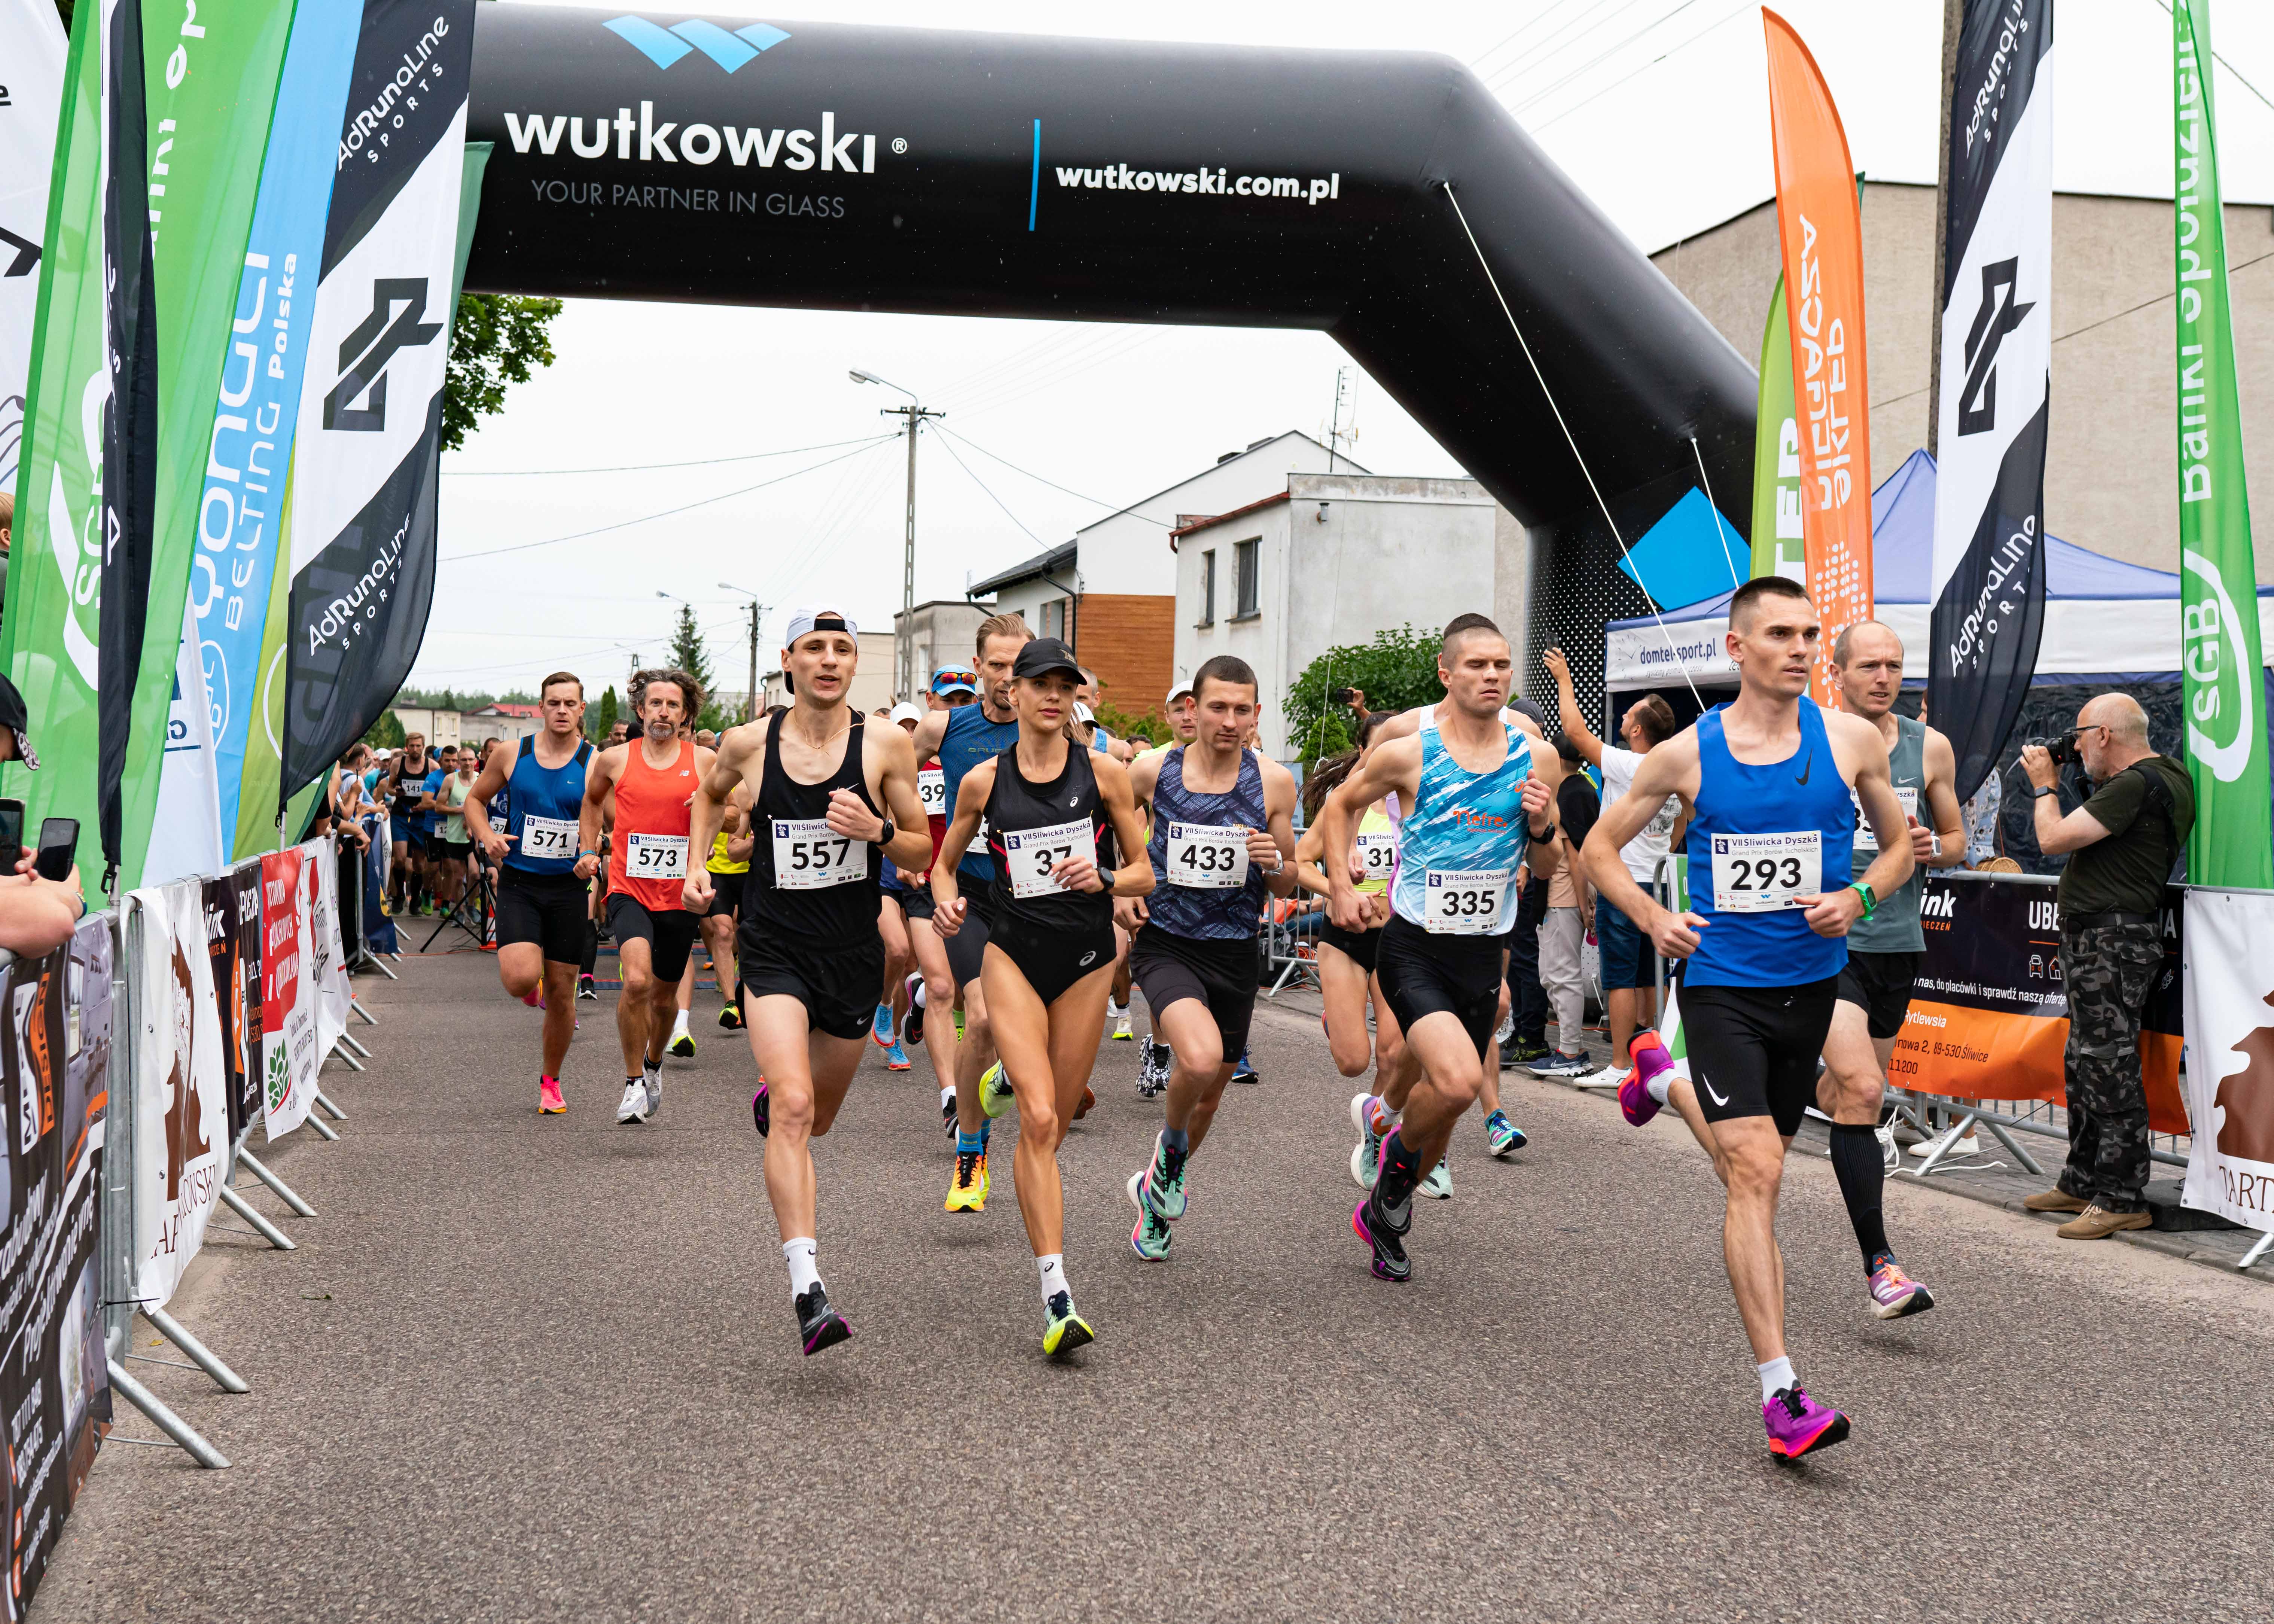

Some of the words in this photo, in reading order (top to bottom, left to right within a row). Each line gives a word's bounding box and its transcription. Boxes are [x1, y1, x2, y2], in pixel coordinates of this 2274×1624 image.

[368, 64, 443, 163] SPORTS
[504, 100, 876, 173] wutkowski
[1056, 164, 1339, 205] wutkowski.com.pl
[531, 179, 603, 205] YOUR
[613, 185, 719, 212] PARTNER
[729, 191, 756, 214] IN
[766, 193, 845, 218] GLASS
[225, 404, 281, 631] BELTING
[268, 254, 297, 379] Polska
[343, 558, 402, 650] SPORTS
[1973, 581, 2025, 669] SPORT
[1640, 638, 1716, 664] domtel-sport.pl
[2184, 598, 2220, 720] SGB
[533, 830, 567, 848] 571
[1033, 829, 1064, 839] Śliwicka
[1066, 822, 1091, 834] Dyszka
[1067, 831, 1091, 842] Tucholskich
[1195, 827, 1223, 836] Śliwicka
[1744, 837, 1781, 846] Śliwicka
[1786, 836, 1817, 845] Dyszka
[638, 848, 677, 867] 573
[792, 839, 850, 870] 557
[1180, 845, 1235, 871] 433
[1368, 848, 1394, 867] 31
[1486, 872, 1508, 881] Dyszka
[1731, 857, 1801, 890] 293
[1442, 890, 1495, 916] 335
[1918, 978, 1935, 990] nas,
[1936, 978, 1945, 989] do
[1946, 980, 1976, 995] placówki
[1979, 984, 1981, 995] i
[1983, 985, 2017, 1000] sprawdź
[2018, 990, 2044, 1006] naszą
[1921, 1040, 1930, 1054] 2,
[1933, 1043, 1961, 1058] 89-530
[1961, 1045, 1988, 1062] Śliwice
[1887, 1059, 1918, 1074] 11200
[2219, 1165, 2274, 1213] TART
